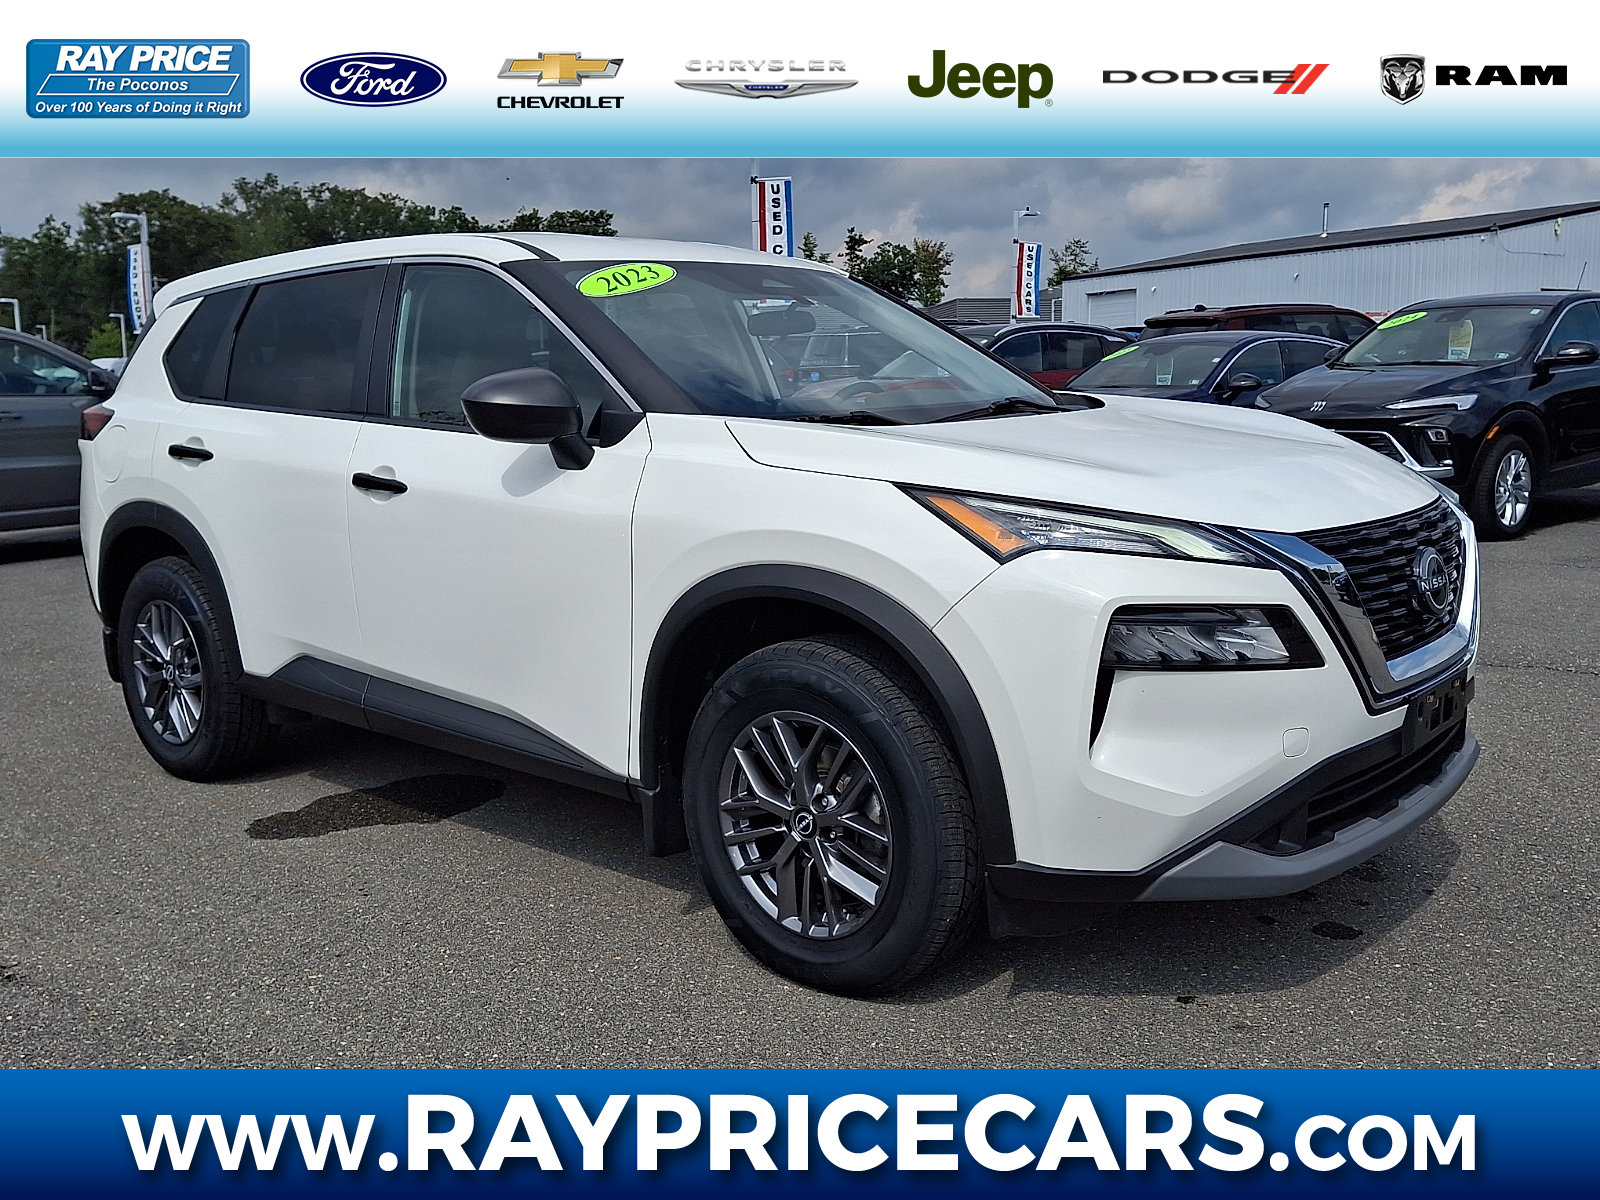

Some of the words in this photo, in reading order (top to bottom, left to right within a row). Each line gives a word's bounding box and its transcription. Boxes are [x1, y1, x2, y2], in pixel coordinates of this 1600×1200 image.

[771, 184, 783, 235] USED
[1026, 245, 1034, 277] USED
[596, 265, 660, 293] 2023
[1420, 574, 1447, 591] NISSA
